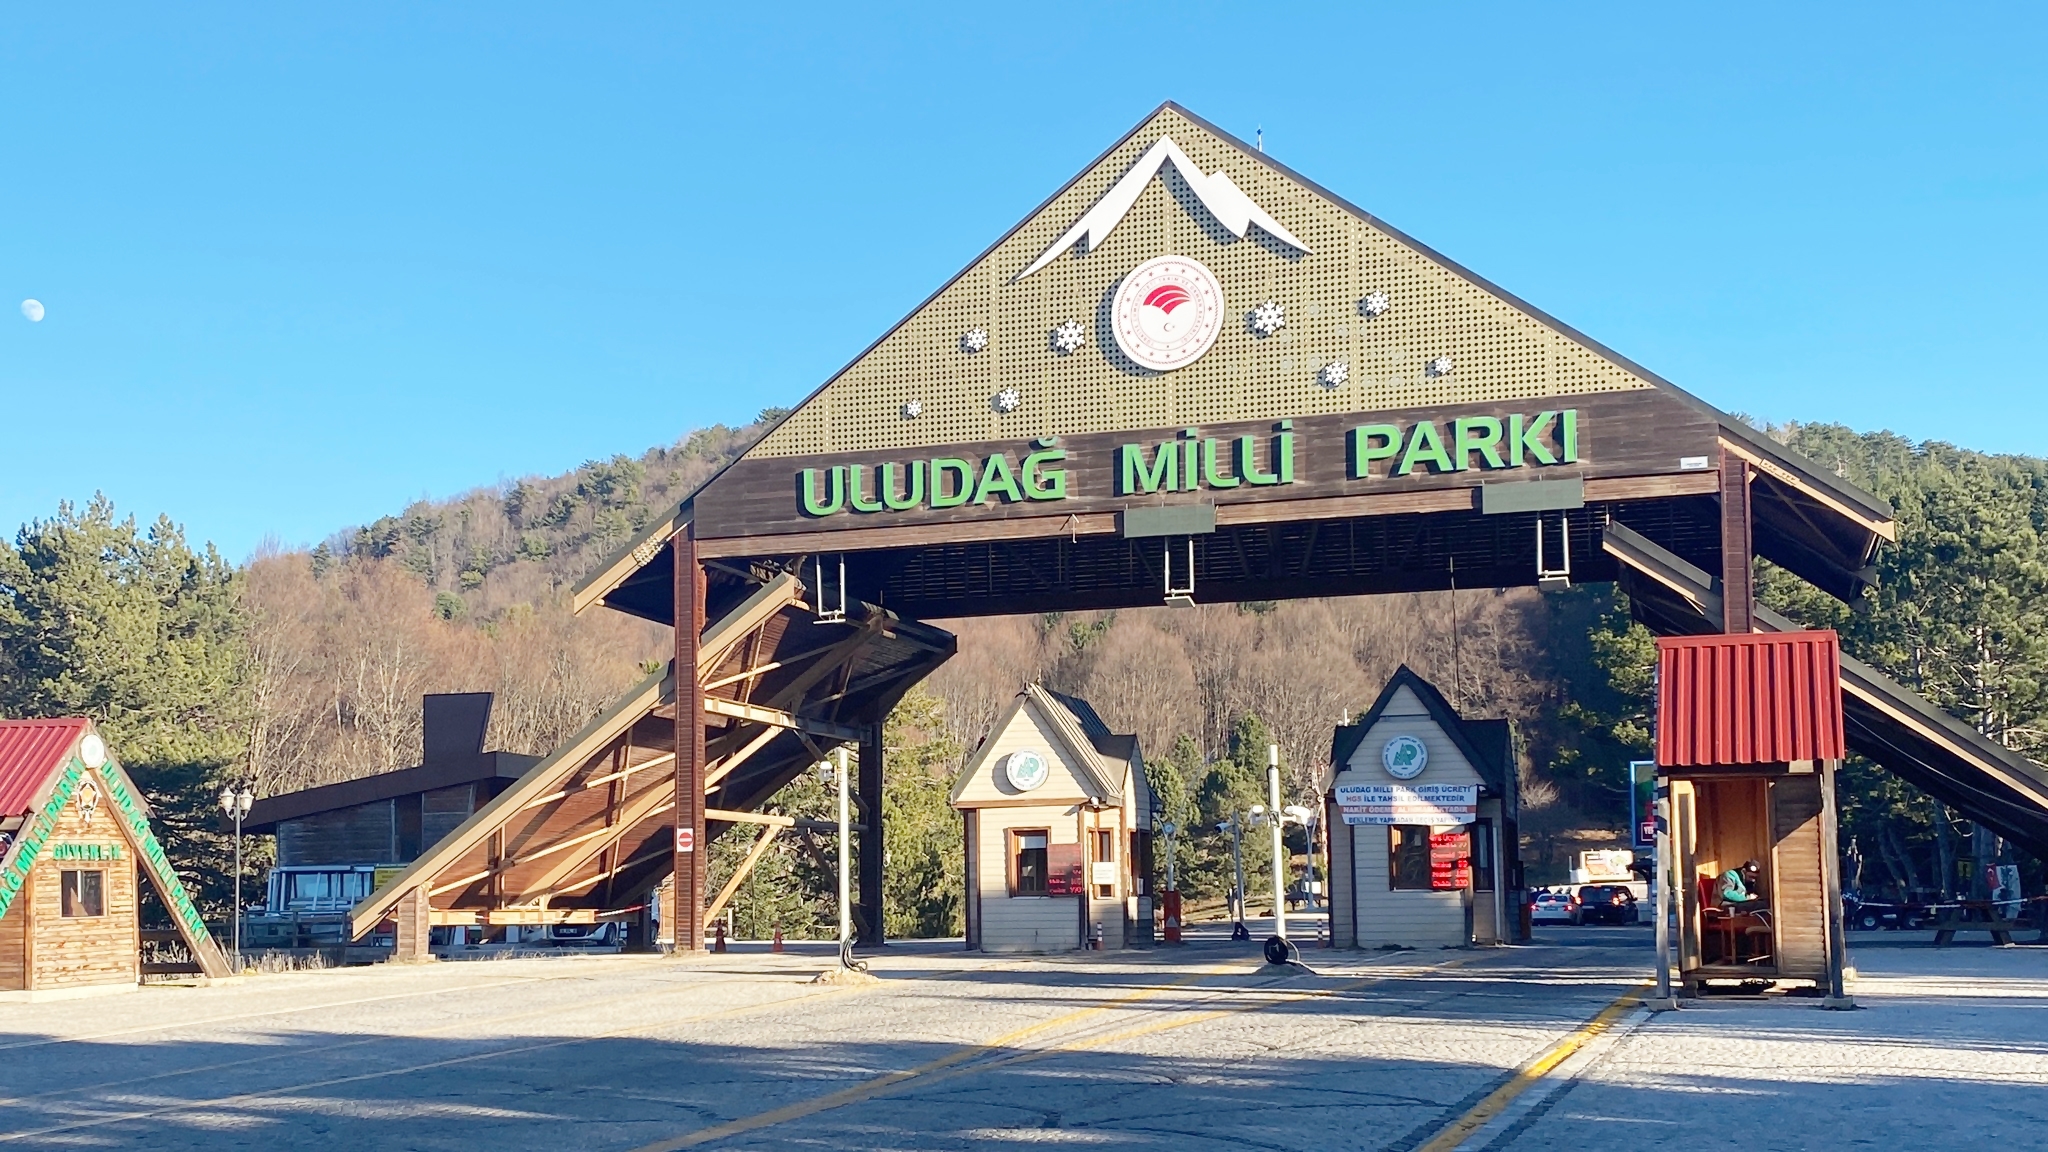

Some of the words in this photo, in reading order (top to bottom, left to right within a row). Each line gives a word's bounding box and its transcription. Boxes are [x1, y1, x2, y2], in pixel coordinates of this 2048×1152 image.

[803, 436, 1066, 516] ULUDAĞ
[1121, 419, 1294, 496] MİLLİ
[1356, 409, 1578, 478] PARKI
[44, 756, 87, 822] PARKI
[1418, 785, 1439, 795] GİRİŞ
[100, 759, 151, 838] ULUDAĞ
[143, 833, 178, 888] MİLLİ
[170, 885, 208, 944] PARKI
